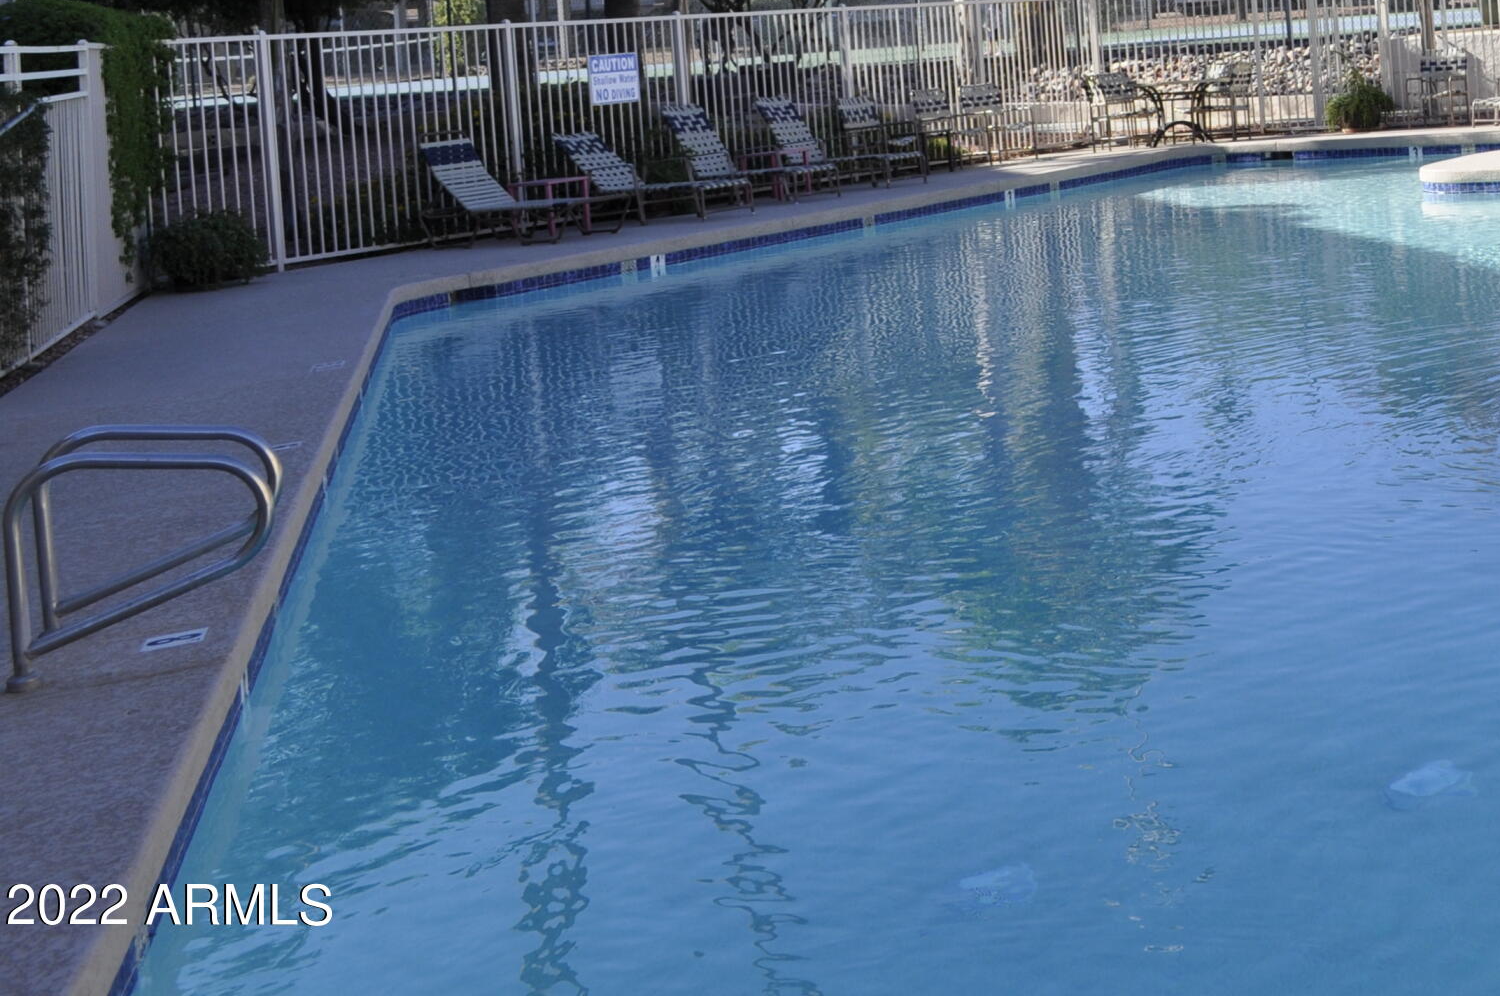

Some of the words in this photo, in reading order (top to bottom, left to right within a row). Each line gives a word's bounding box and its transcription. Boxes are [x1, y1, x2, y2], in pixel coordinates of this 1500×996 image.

[592, 57, 635, 73] CAUTION
[596, 88, 609, 101] NO
[612, 87, 636, 100] DIVING
